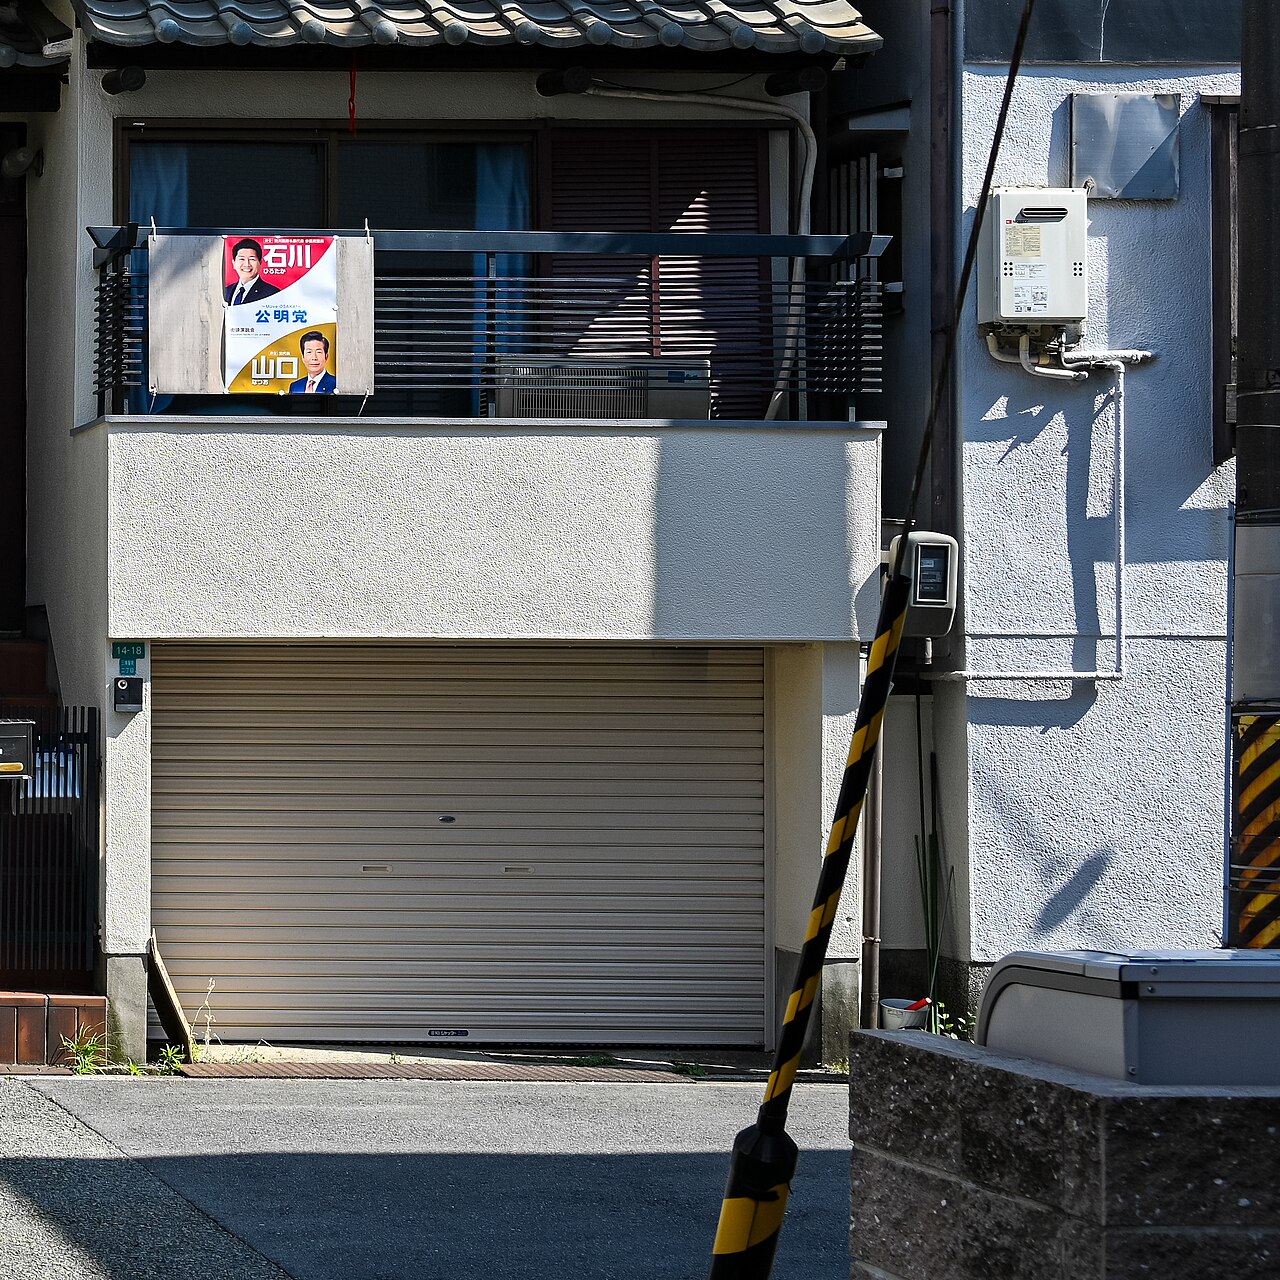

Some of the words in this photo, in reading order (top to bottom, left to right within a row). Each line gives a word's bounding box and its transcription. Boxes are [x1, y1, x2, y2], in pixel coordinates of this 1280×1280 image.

[263, 244, 311, 269] 石川
[255, 309, 308, 323] 公明党
[251, 355, 299, 379] 山口
[117, 646, 142, 655] 14-18
